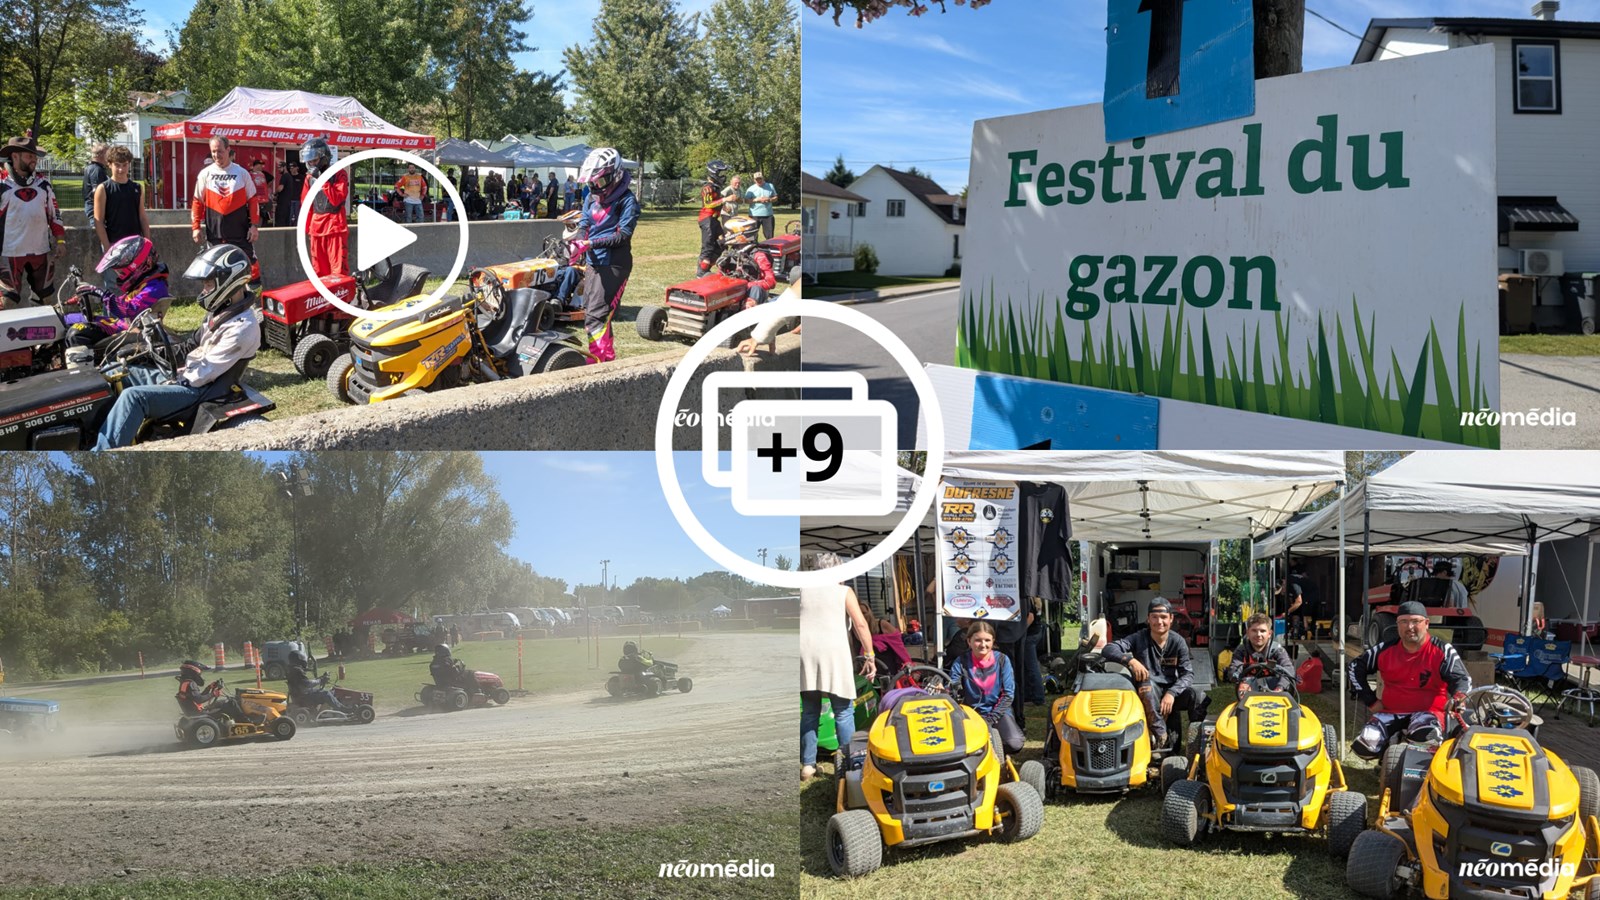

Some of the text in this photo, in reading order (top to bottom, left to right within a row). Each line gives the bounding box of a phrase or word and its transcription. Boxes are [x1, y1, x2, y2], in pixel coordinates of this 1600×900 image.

[339, 115, 363, 128] 28
[210, 126, 244, 136] ÉQUIPE
[246, 129, 258, 137] DE
[260, 131, 294, 139] COURSE
[366, 136, 375, 144] DE
[1004, 114, 1410, 208] Festival du
[1065, 254, 1281, 320] gazon
[5, 424, 19, 434] HP
[25, 417, 43, 429] 306
[44, 414, 57, 423] CC
[63, 410, 75, 418] 36
[76, 403, 93, 414] CUT
[21, 410, 38, 419] Start
[943, 486, 1015, 499] DUFRESNE
[943, 503, 974, 514] RR
[234, 725, 249, 735] 65
